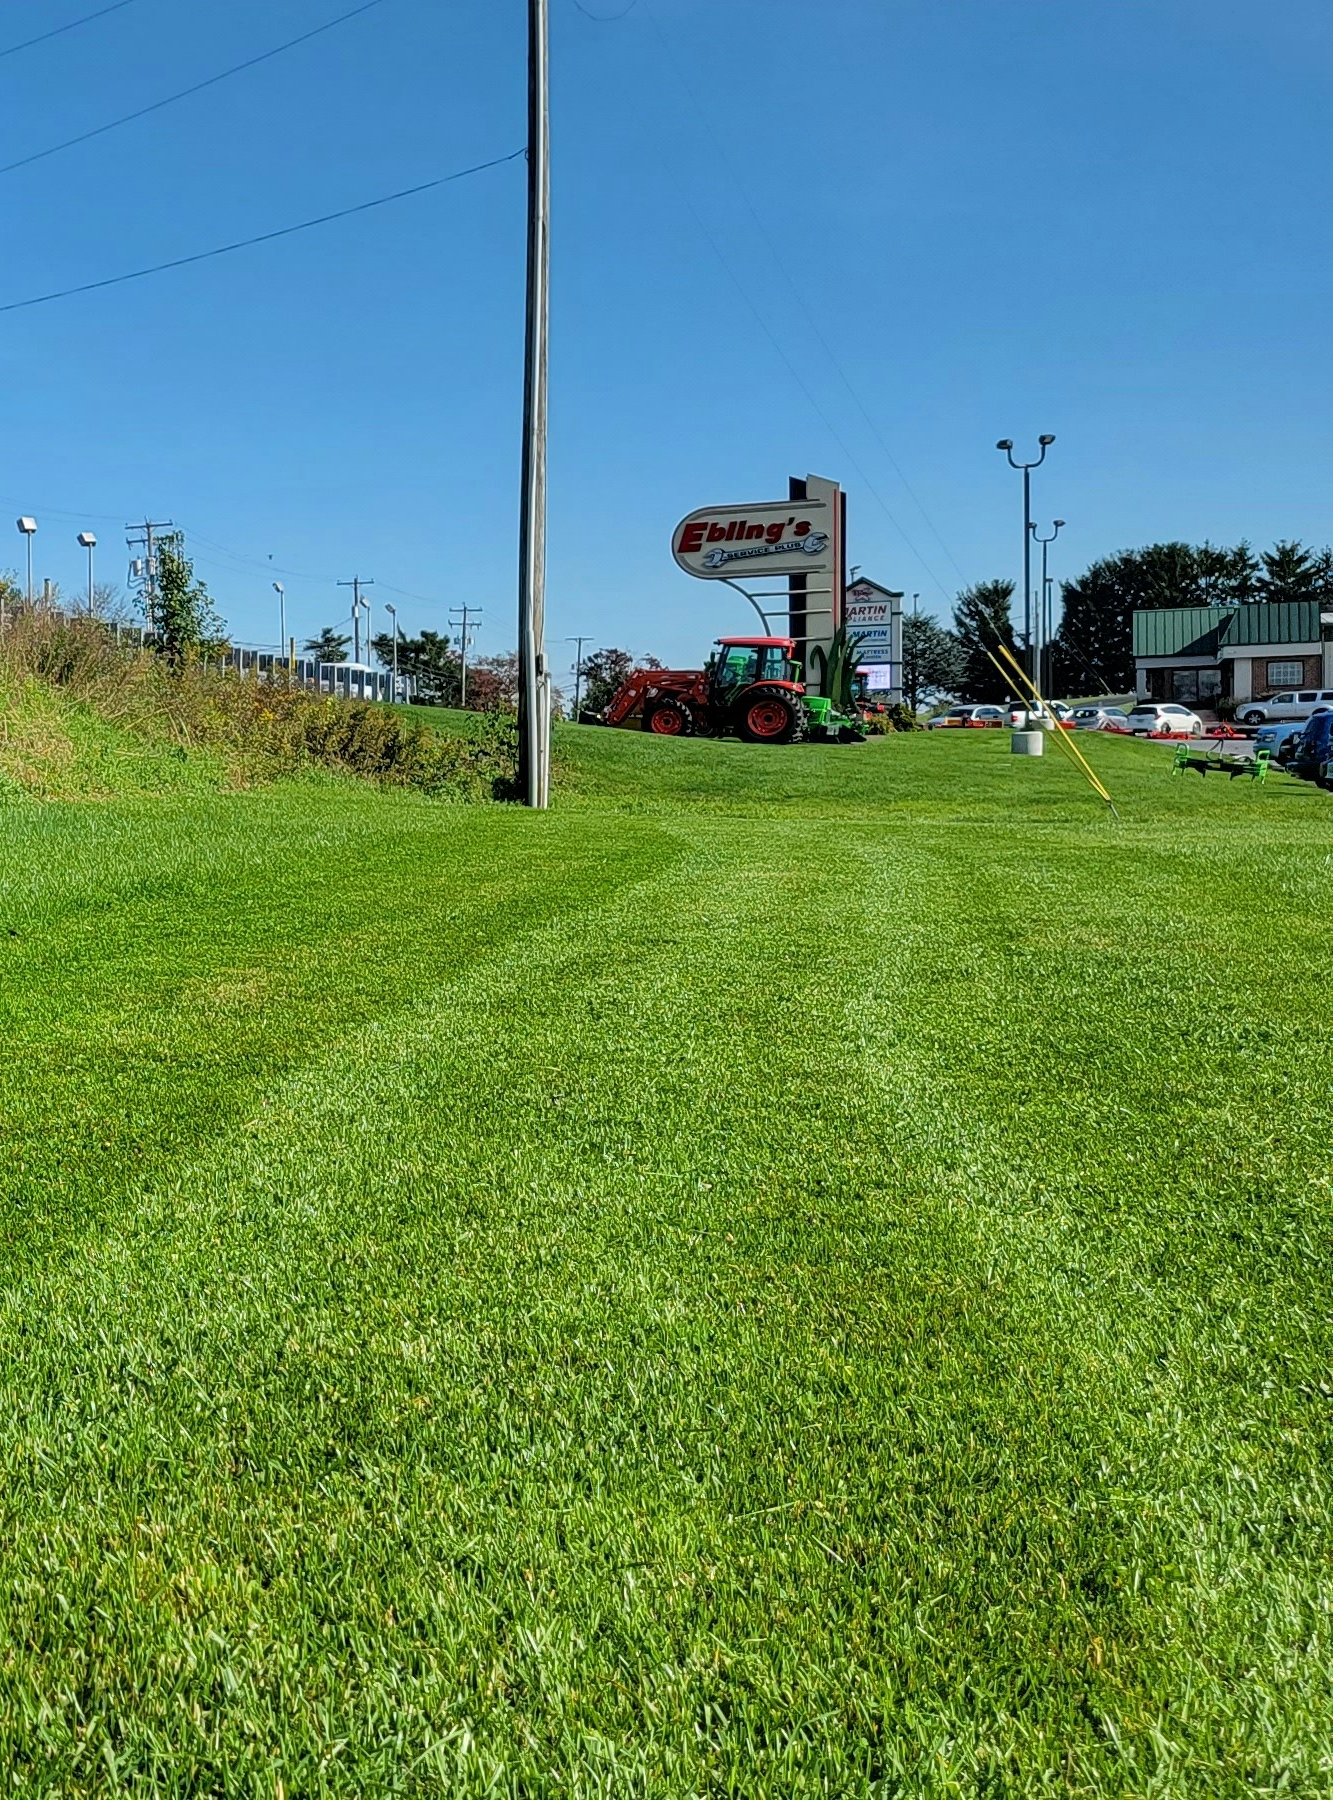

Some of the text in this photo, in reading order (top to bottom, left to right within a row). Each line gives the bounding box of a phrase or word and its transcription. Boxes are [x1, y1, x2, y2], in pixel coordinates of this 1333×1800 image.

[678, 517, 812, 553] Ebling's
[727, 541, 802, 559] SERVICE PLUS
